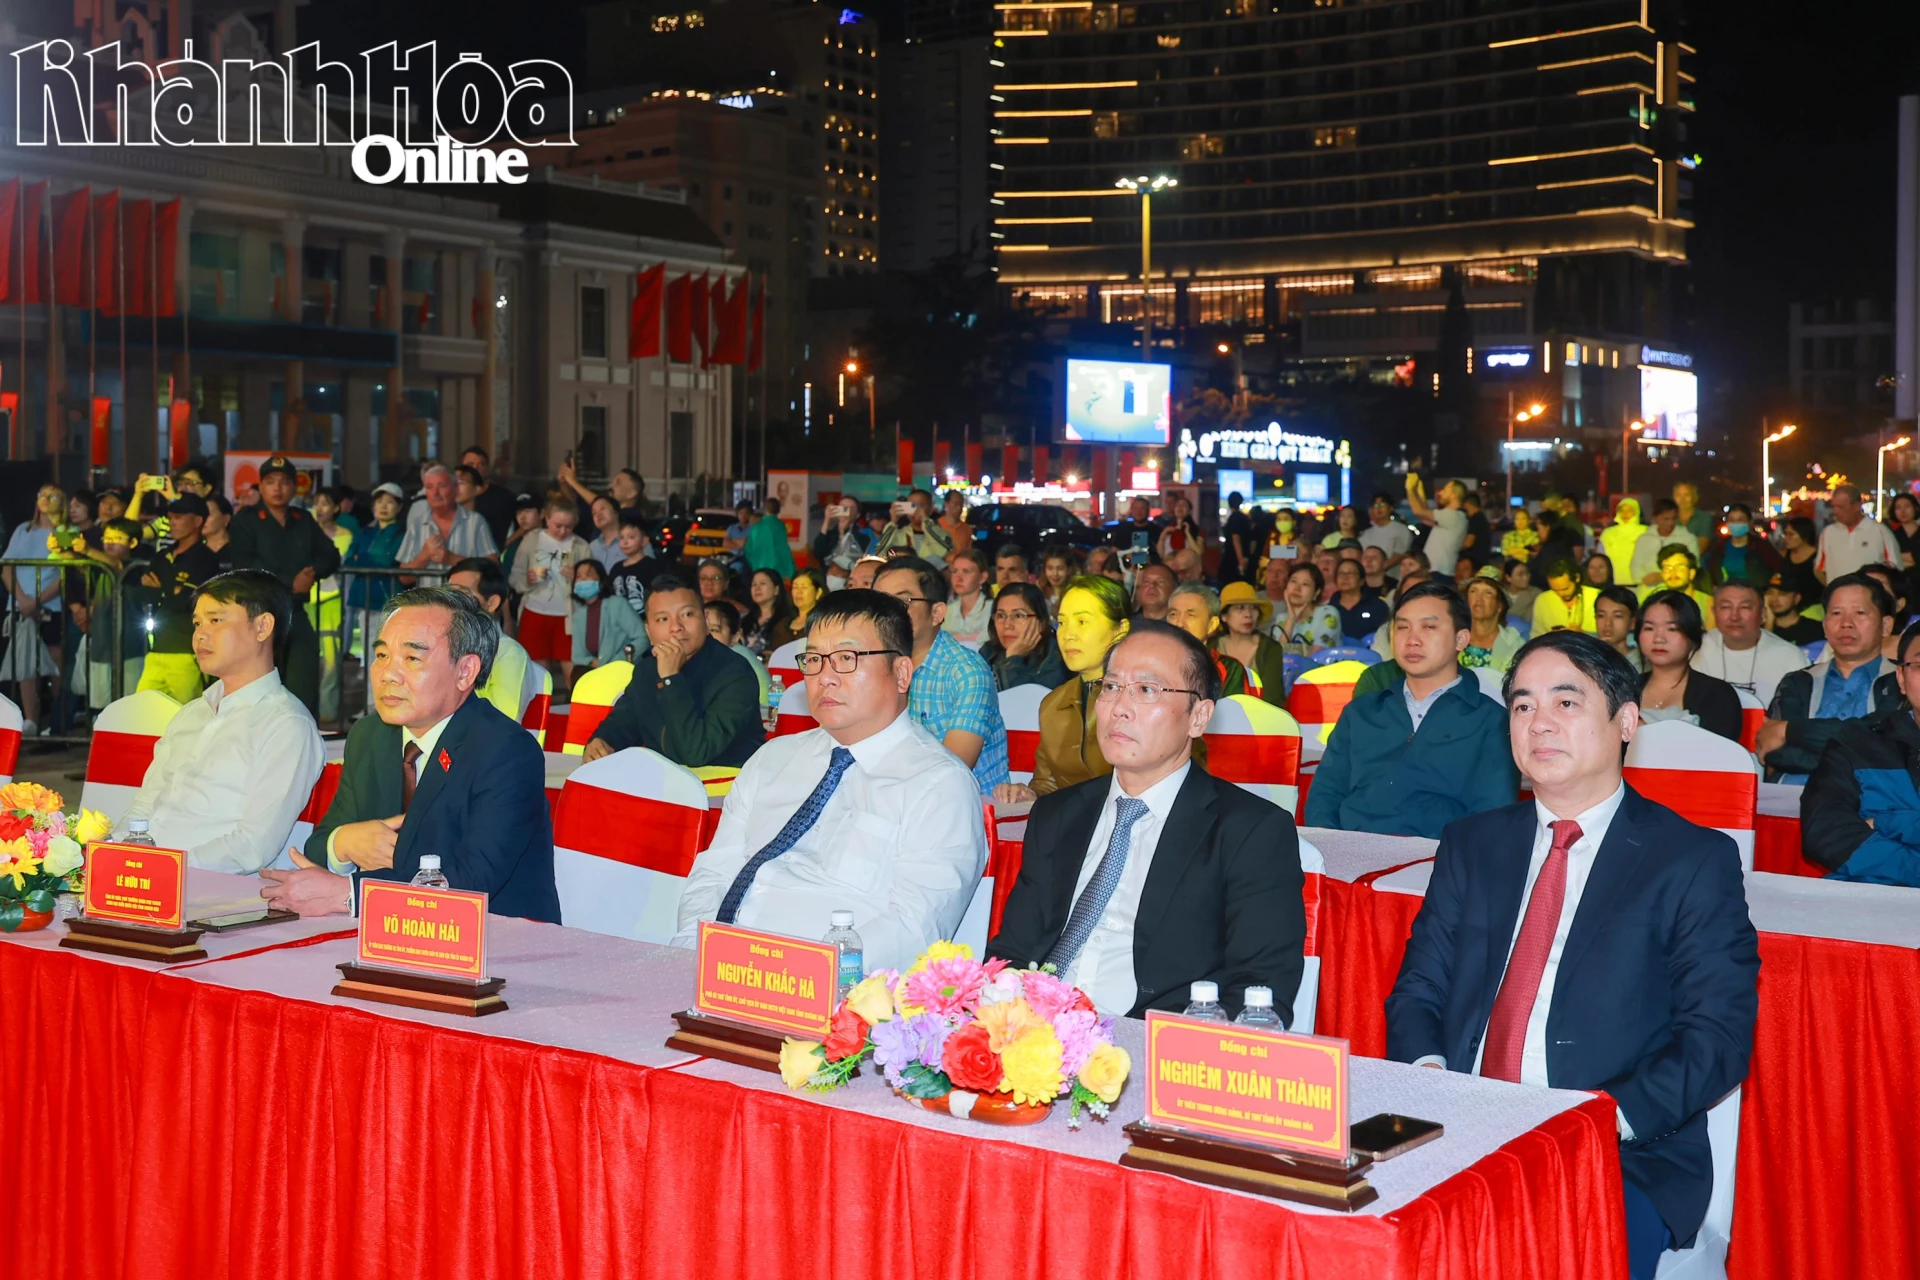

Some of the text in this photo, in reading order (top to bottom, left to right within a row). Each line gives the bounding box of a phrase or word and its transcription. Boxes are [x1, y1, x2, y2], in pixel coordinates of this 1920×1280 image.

[116, 873, 124, 887] LÊ
[139, 877, 151, 890] TRÍ
[426, 899, 438, 909] chí
[383, 914, 460, 943] VÕ HOÀN HẢI
[771, 948, 784, 959] chí
[716, 961, 815, 1000] NGUYỄN KHẮC HÀ
[1219, 1039, 1268, 1058] Đồng chí
[1159, 1059, 1332, 1111] NGHIÊM XUÂN THÀNH
